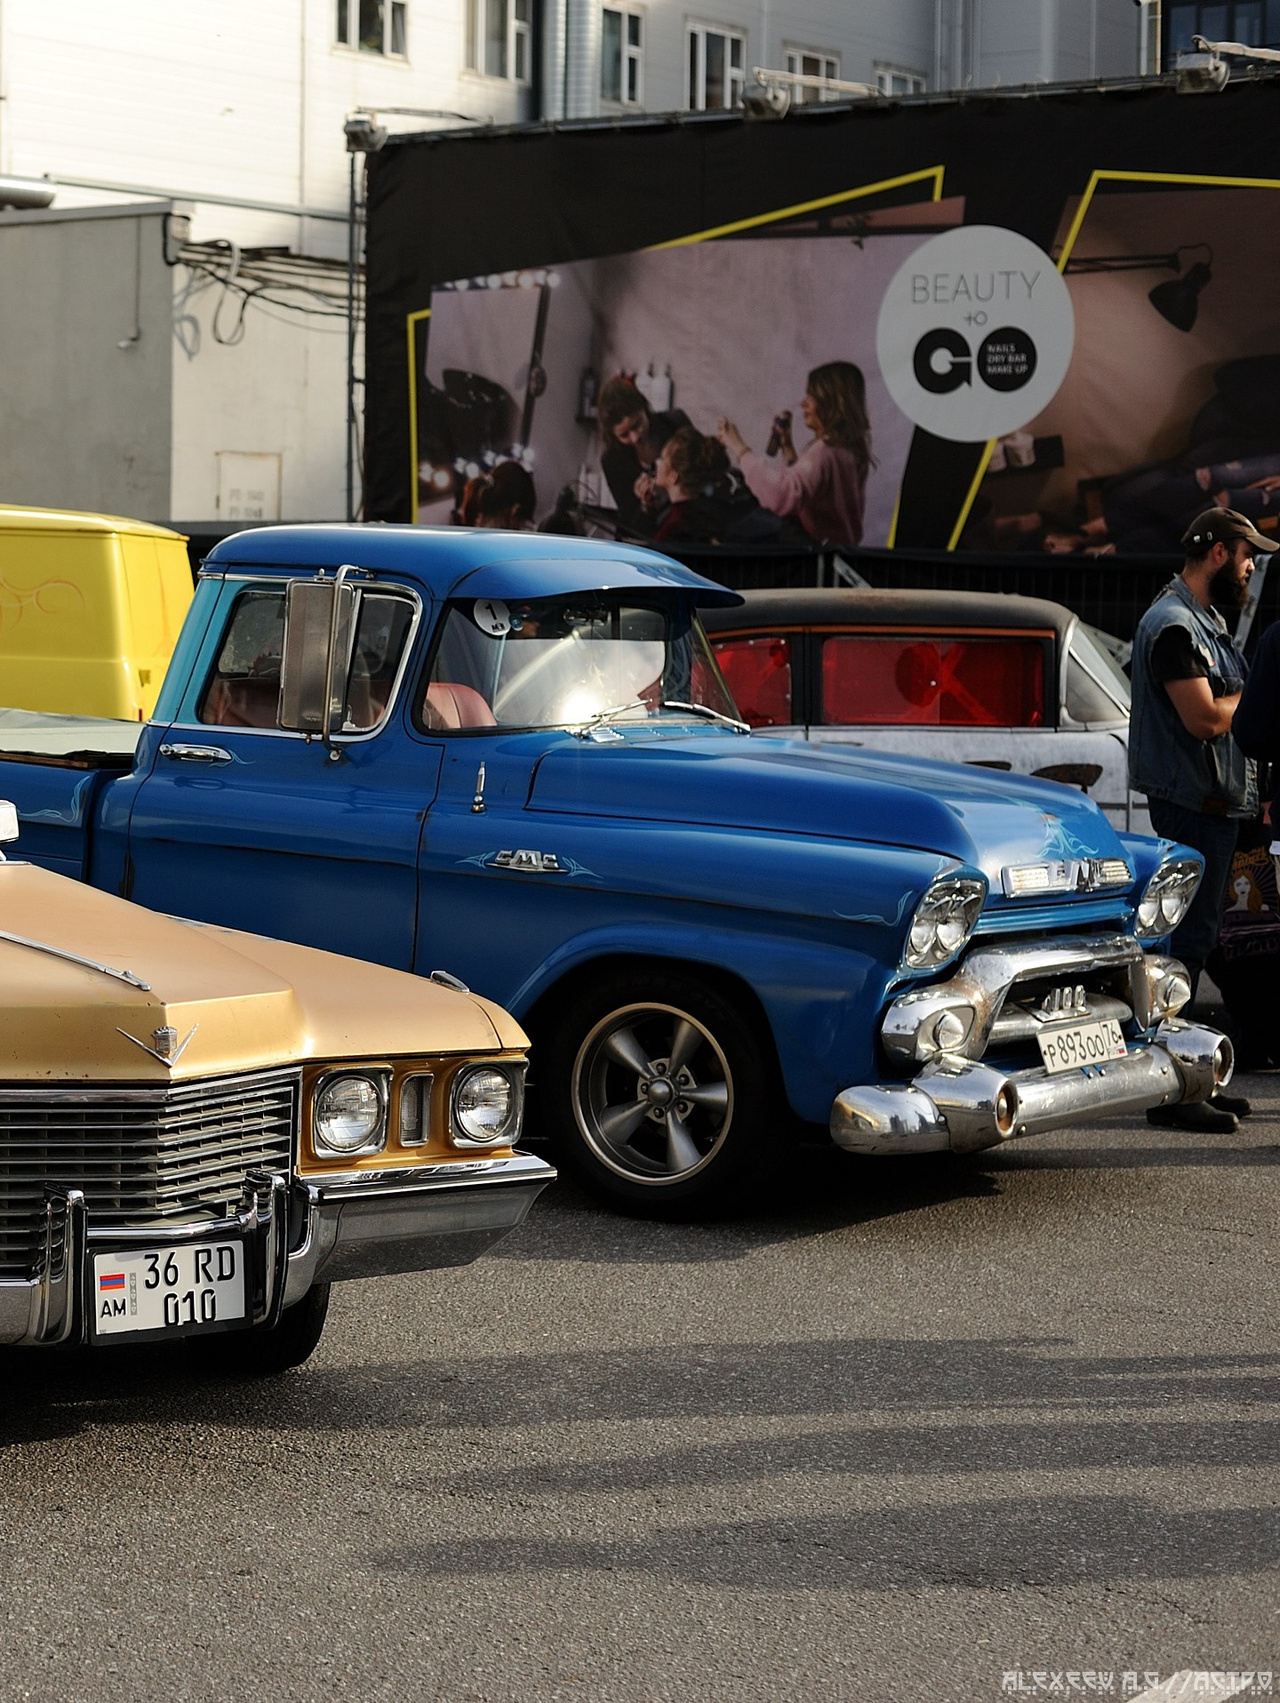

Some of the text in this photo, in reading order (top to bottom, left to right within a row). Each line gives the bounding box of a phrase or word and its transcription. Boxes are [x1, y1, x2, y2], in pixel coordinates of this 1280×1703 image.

[911, 270, 1041, 304] BEAUTY
[986, 342, 1016, 354] NAILS
[913, 326, 1038, 394] GO
[986, 353, 1028, 365] DRY BAR
[986, 363, 1029, 376] MAKE UP
[485, 602, 498, 621] 1
[495, 849, 559, 871] GMC
[144, 1245, 236, 1289] 36 RD
[100, 1298, 127, 1319] AM
[163, 1288, 217, 1326] 010
